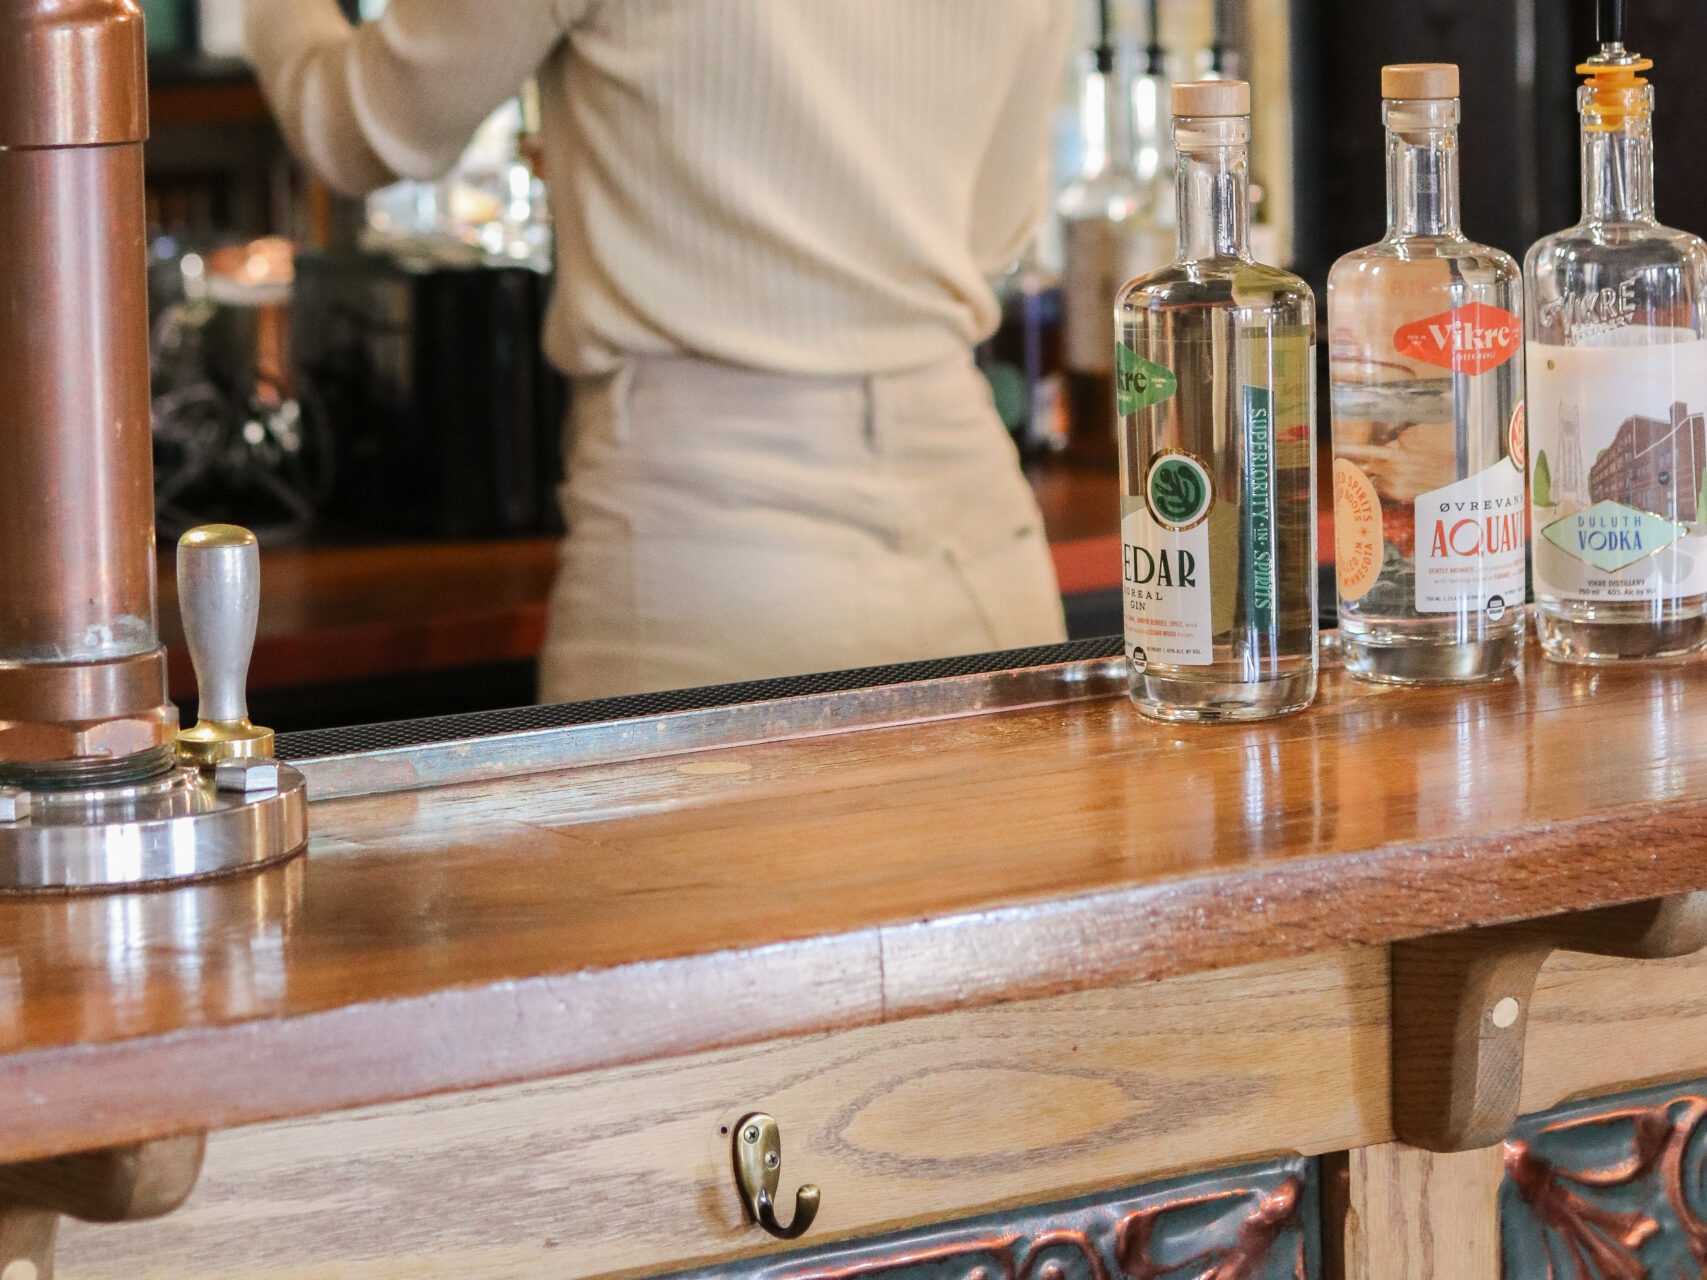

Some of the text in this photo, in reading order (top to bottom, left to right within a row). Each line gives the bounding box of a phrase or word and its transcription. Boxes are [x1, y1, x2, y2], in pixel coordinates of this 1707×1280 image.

[1428, 320, 1511, 351] Vikre
[1251, 408, 1269, 520] SUPERIORITY
[1348, 475, 1373, 522] SPIRITS
[1578, 516, 1641, 528] DULUTH
[1578, 530, 1642, 551] VODKA
[1123, 544, 1196, 587] EDAR
[1253, 550, 1272, 609] SPIRITS
[1608, 579, 1646, 587] DISTILLERY
[1130, 600, 1146, 611] GIN
